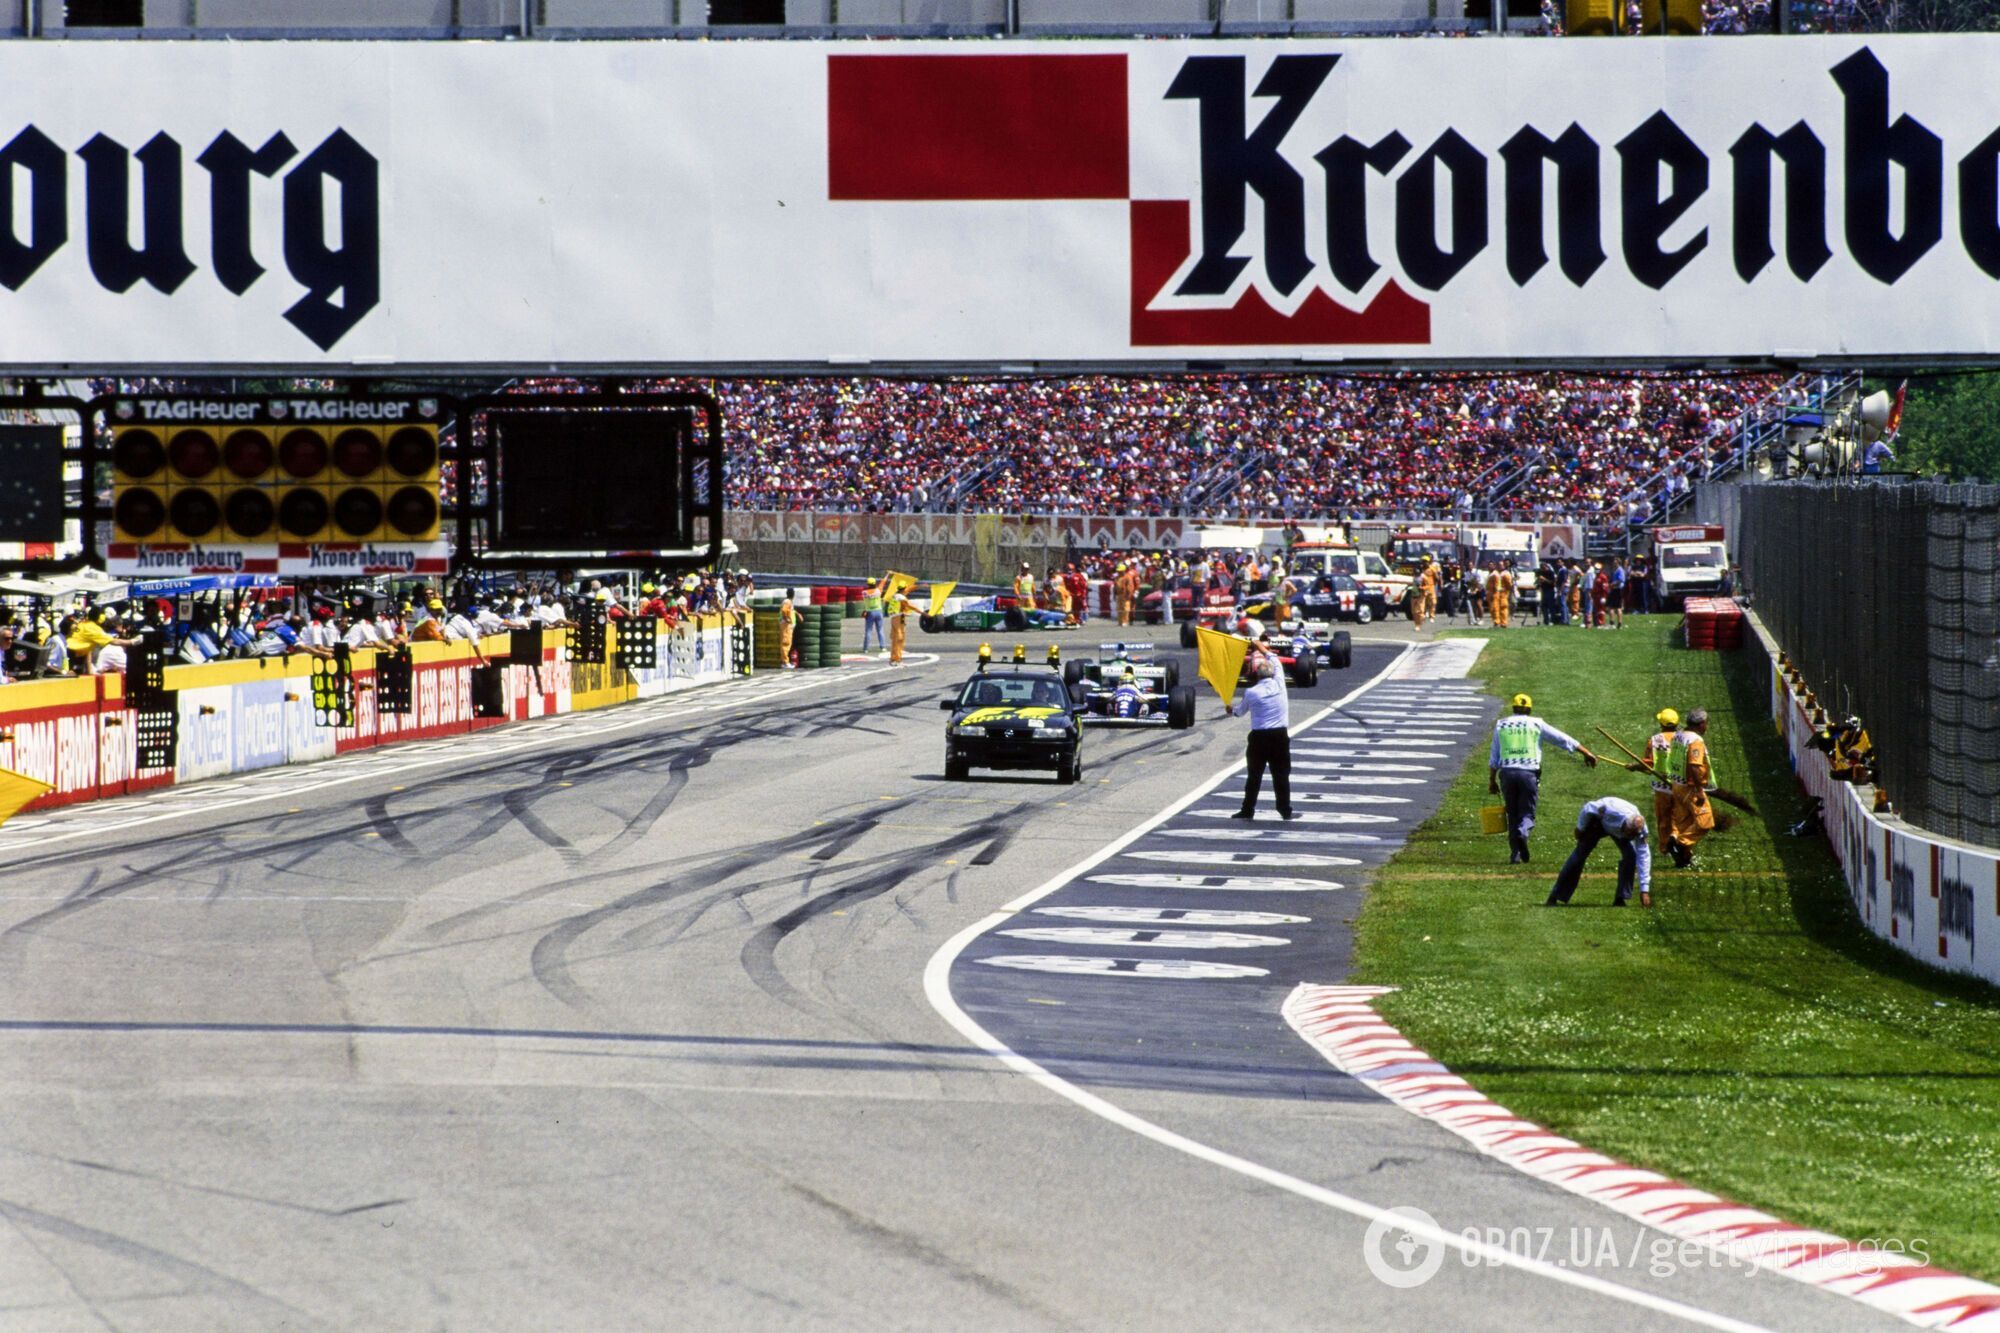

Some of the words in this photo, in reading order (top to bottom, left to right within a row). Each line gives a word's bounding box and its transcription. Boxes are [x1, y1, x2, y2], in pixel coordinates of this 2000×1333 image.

[136, 545, 245, 573] Kronenbourg
[309, 545, 416, 572] Kronenbourg
[139, 583, 162, 592] MILD
[164, 580, 192, 590] SEVEN
[57, 714, 97, 793] FERODO
